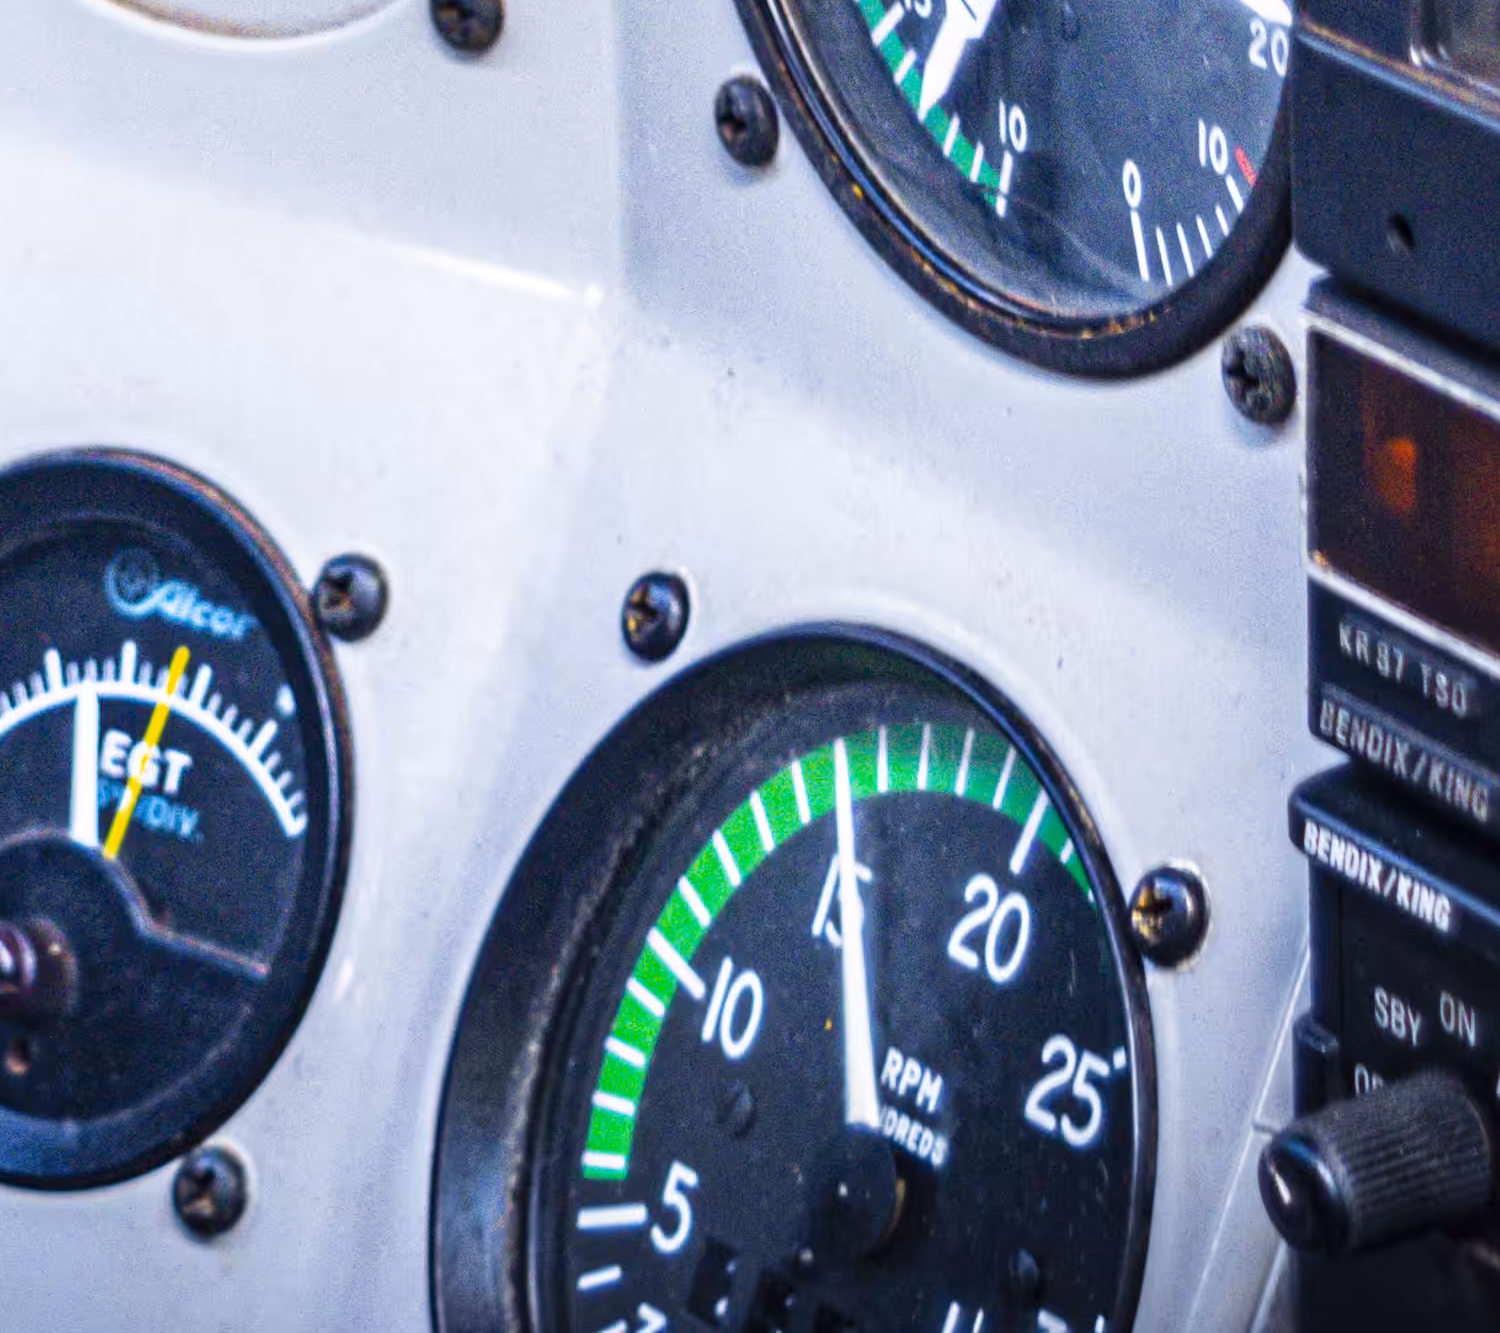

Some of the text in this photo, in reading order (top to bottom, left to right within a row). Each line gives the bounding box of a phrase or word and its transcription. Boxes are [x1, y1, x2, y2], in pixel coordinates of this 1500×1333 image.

[1248, 18, 1290, 77] 20
[998, 100, 1028, 153] 10
[1198, 117, 1230, 175] 10
[1121, 158, 1142, 207] 0
[1338, 619, 1470, 719] KR 87 TSO
[100, 728, 193, 795] EGT
[1318, 699, 1491, 824] BENDIX/KING
[1303, 818, 1453, 934] BENDIX/KING
[946, 871, 1034, 985] 20
[700, 956, 766, 1061] 10
[1372, 985, 1423, 1048] SBY
[1438, 989, 1478, 1049] ON
[880, 1045, 945, 1114] RPM
[1022, 1034, 1112, 1148] 25
[879, 1105, 950, 1169] DREDS
[649, 1159, 700, 1255] 5
